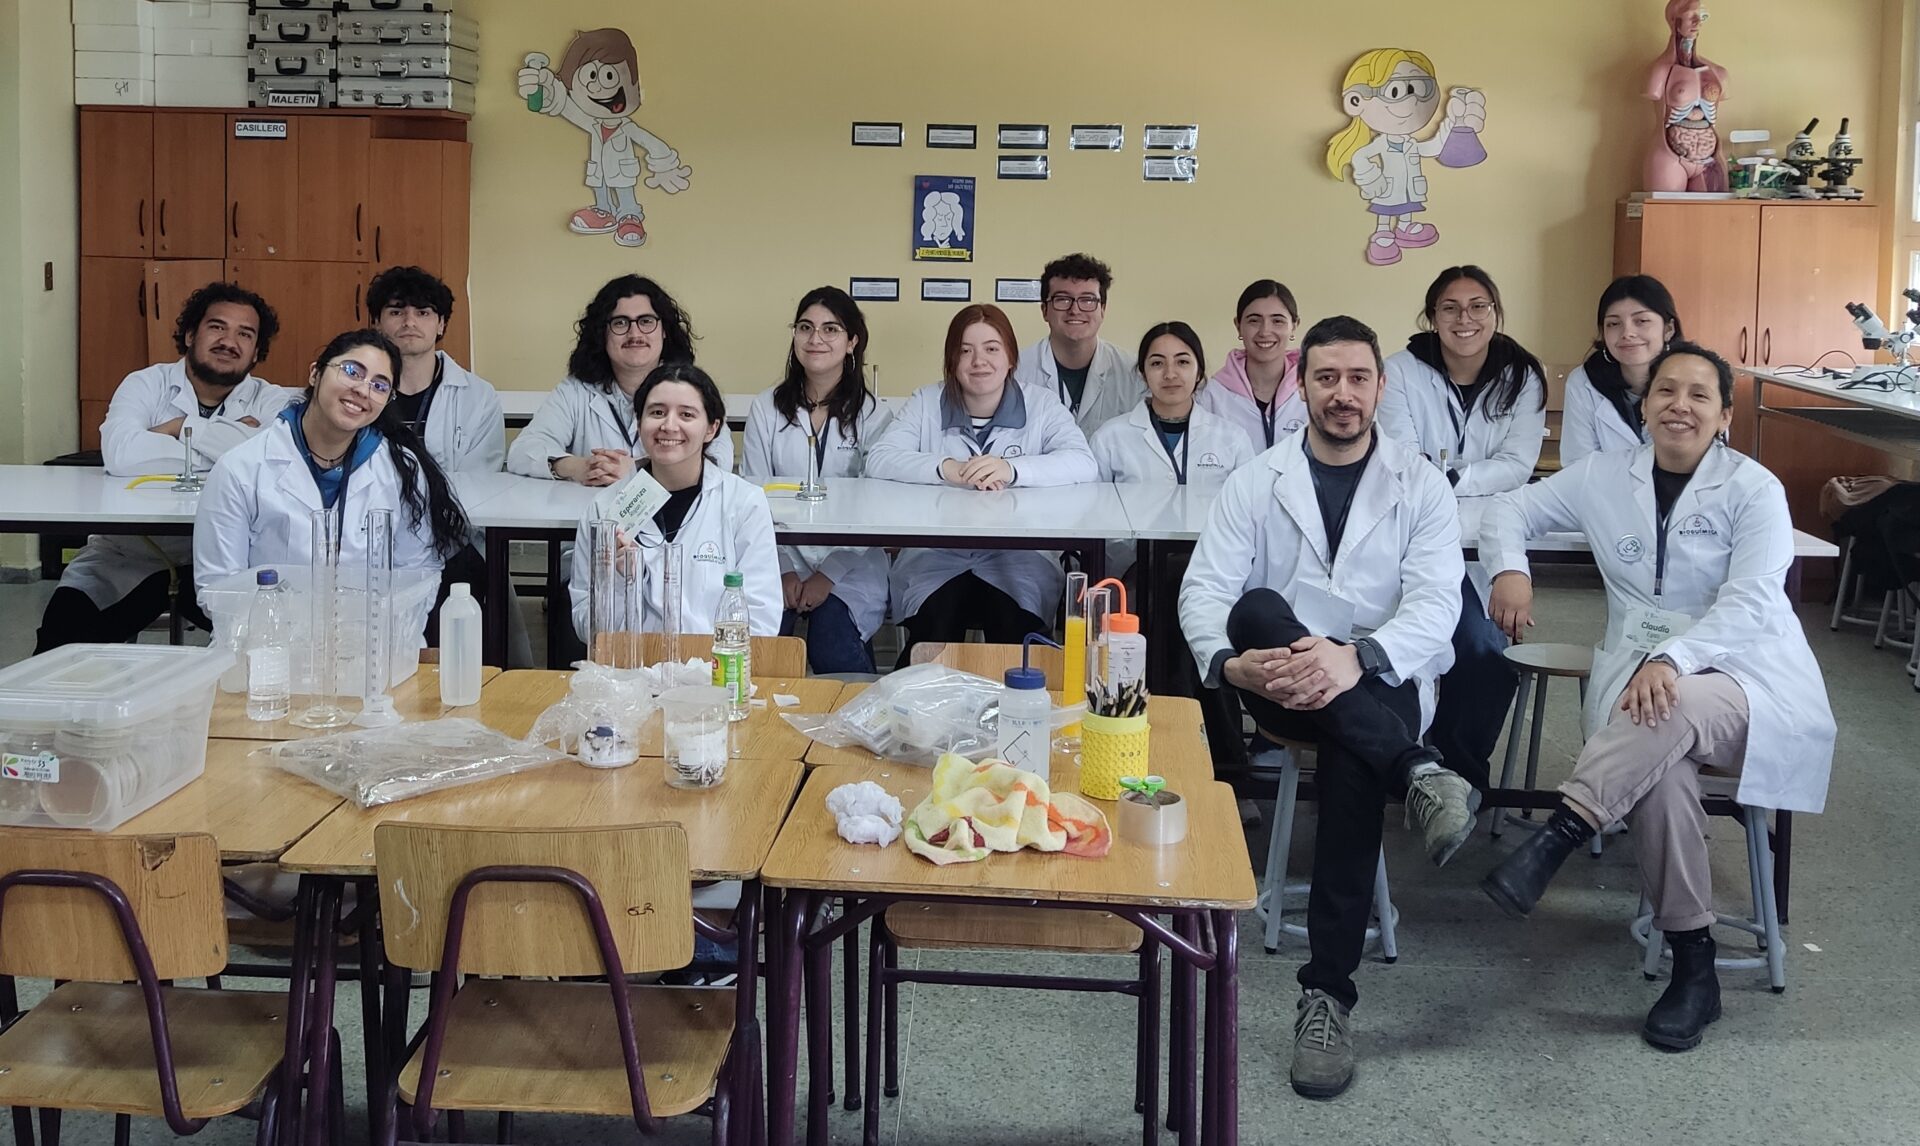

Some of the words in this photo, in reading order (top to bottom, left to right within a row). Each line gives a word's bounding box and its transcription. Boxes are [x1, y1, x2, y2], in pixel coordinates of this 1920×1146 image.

[236, 124, 286, 133] CASILLERO
[619, 487, 647, 518] Esperanza
[1623, 540, 1638, 553] ICB
